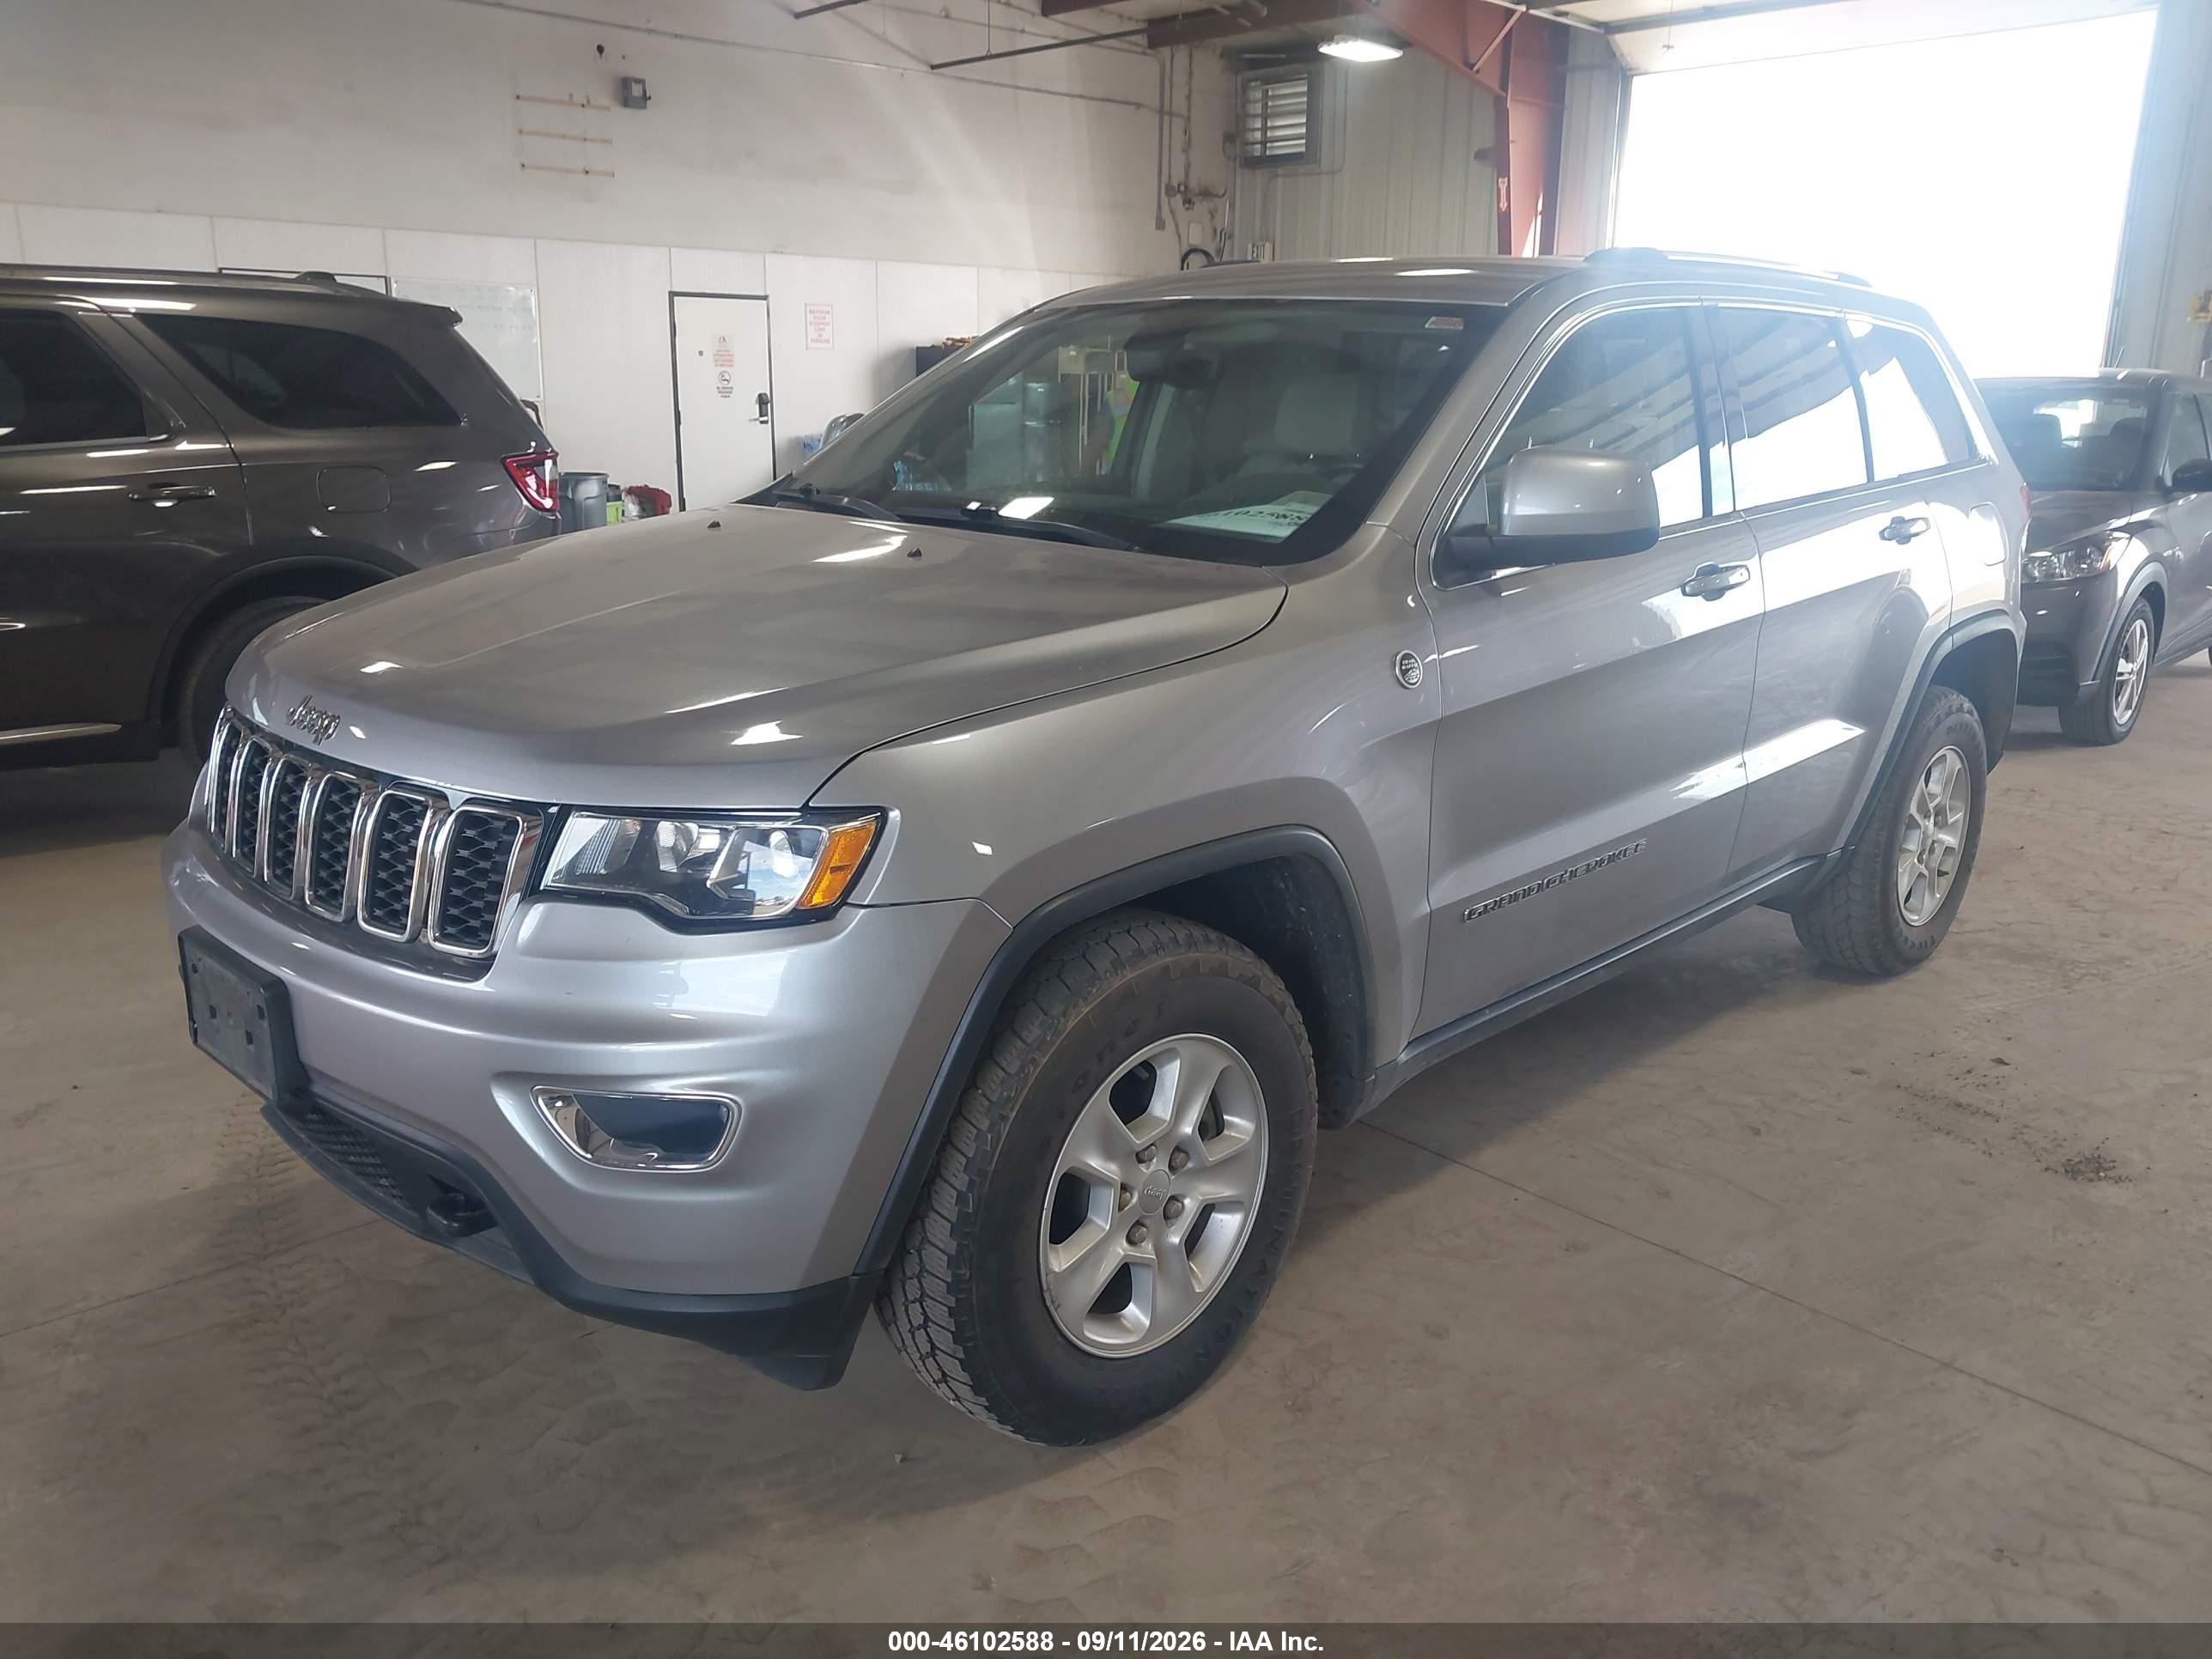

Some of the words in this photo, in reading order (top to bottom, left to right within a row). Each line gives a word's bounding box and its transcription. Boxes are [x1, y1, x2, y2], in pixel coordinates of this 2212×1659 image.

[289, 695, 341, 746] Jeep
[1463, 879, 1543, 921] GRAND
[1544, 838, 1647, 890] CHEROKEE
